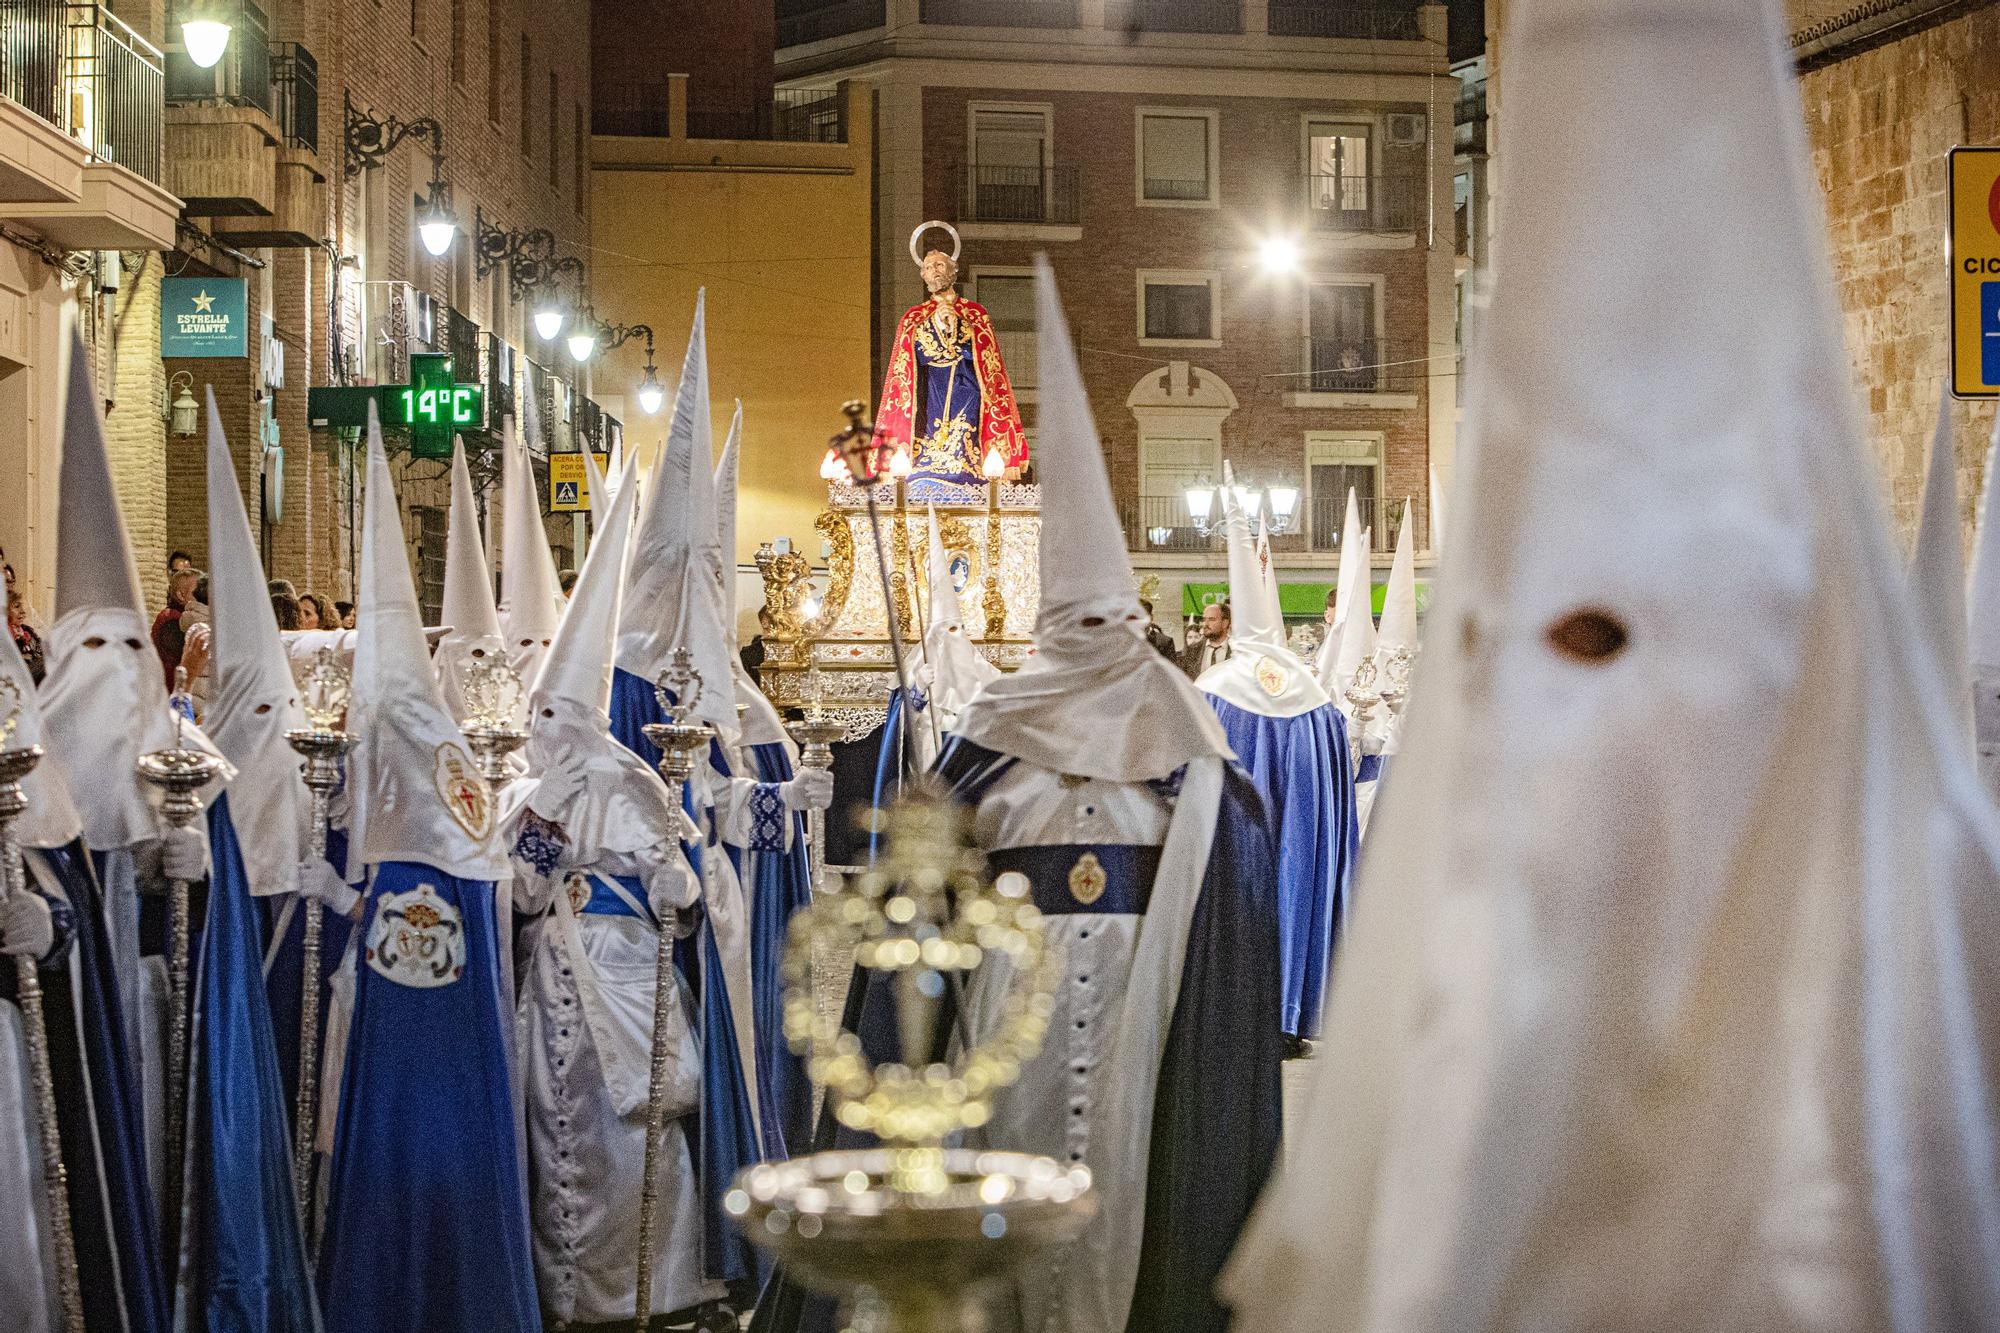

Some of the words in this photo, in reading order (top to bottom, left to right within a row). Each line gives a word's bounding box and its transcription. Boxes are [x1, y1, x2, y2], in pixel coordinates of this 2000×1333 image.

[177, 314, 229, 324] ESTRELLA
[180, 323, 227, 334] LEVANTE
[553, 455, 575, 463] ACERA
